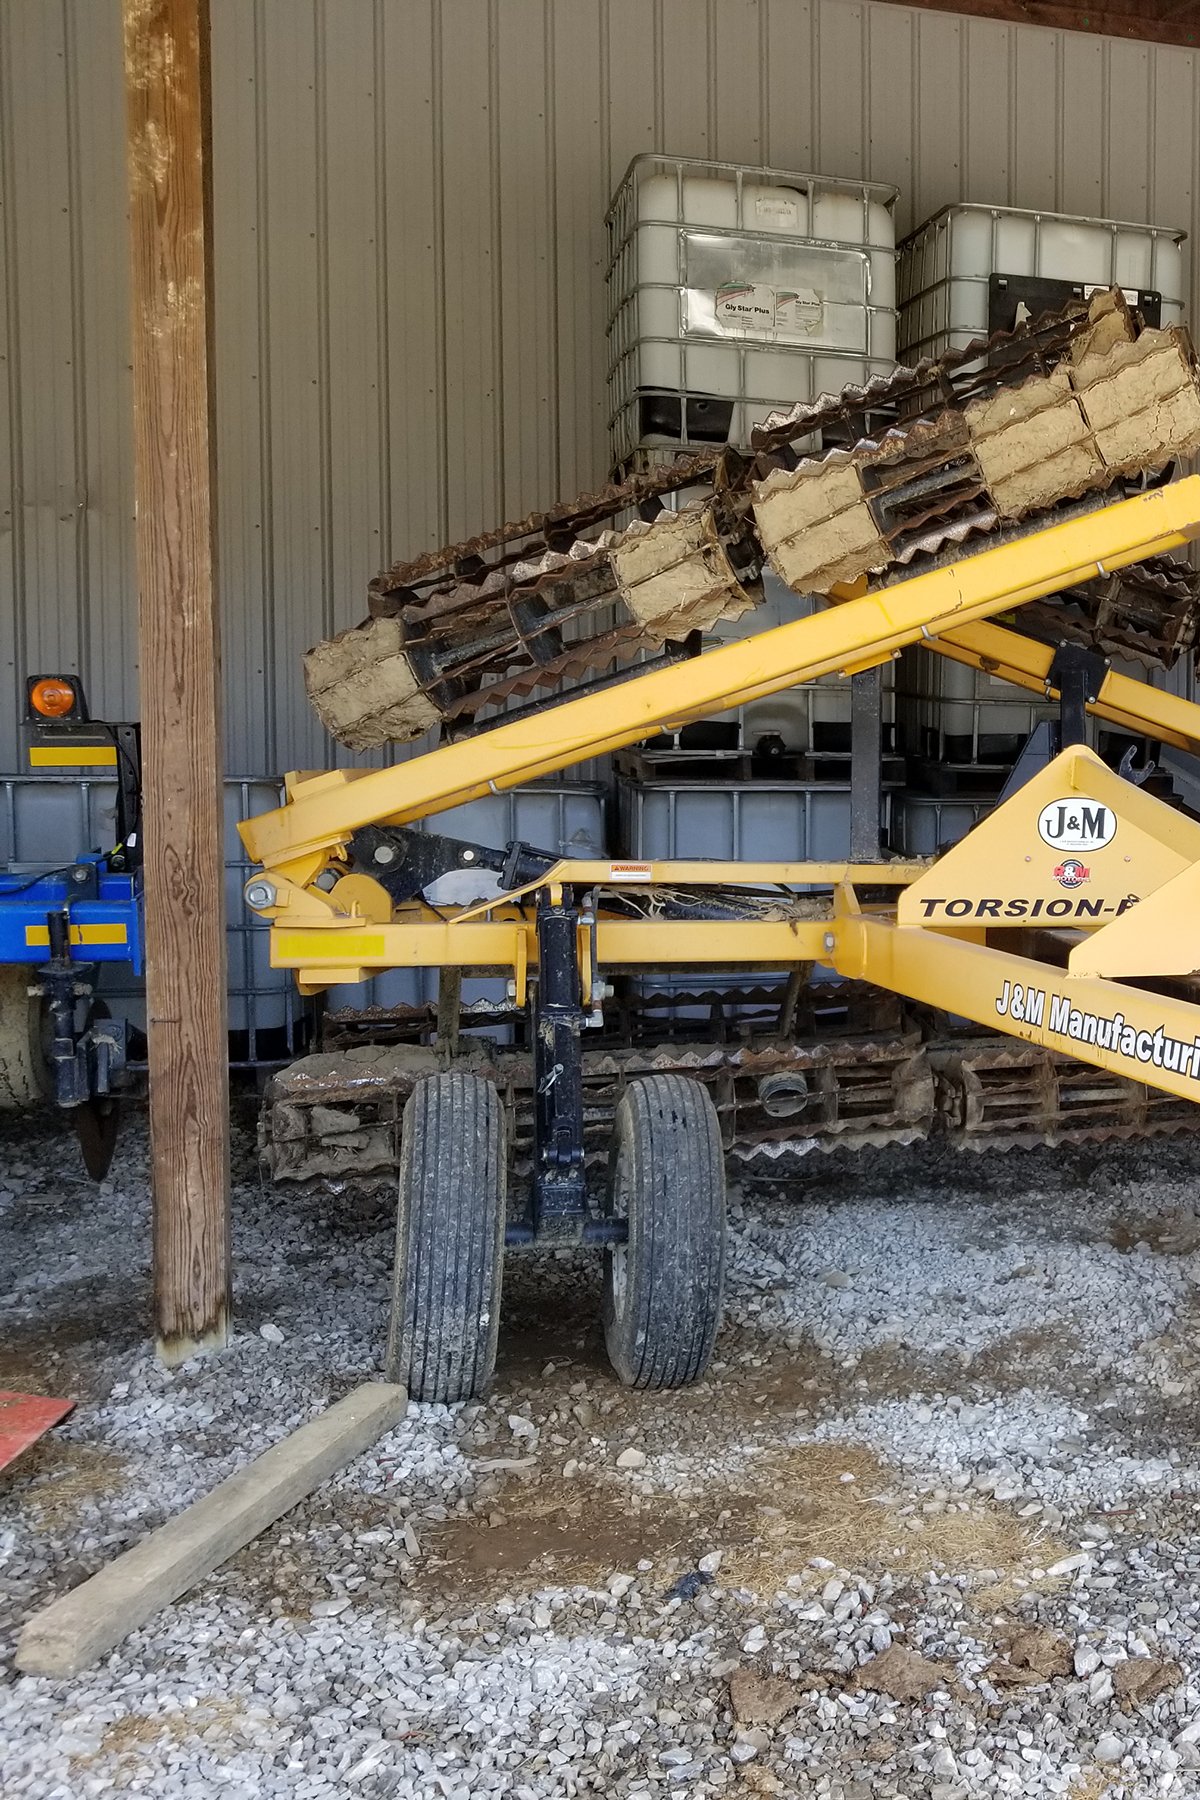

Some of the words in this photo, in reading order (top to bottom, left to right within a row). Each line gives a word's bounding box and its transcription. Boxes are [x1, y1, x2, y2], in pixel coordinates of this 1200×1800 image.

[725, 303, 736, 312] Gly
[738, 304, 752, 312] Star
[754, 306, 770, 314] Plus
[1045, 806, 1107, 839] J&M
